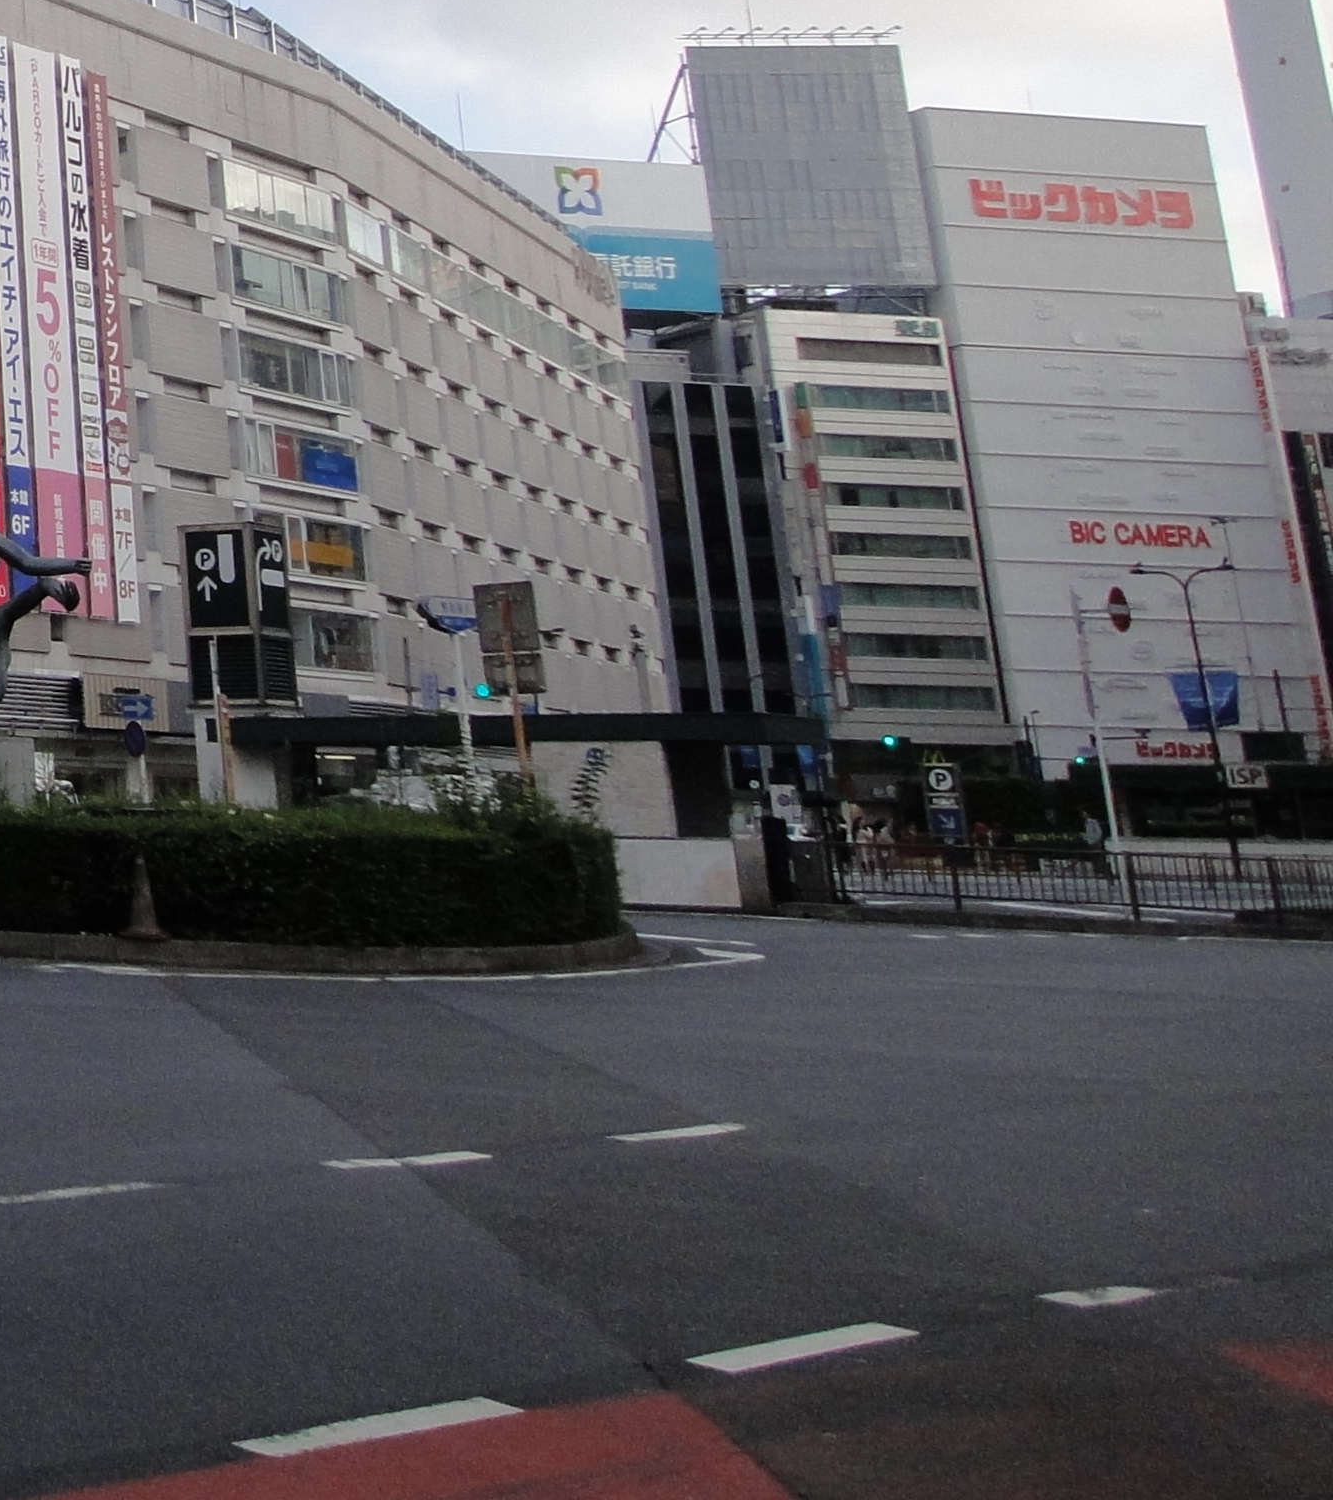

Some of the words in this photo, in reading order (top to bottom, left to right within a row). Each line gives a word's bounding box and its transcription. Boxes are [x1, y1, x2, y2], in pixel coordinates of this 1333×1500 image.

[63, 64, 90, 271] パルコの水着
[967, 178, 1194, 230] ビックカメラ
[101, 223, 121, 406] レストランフロア
[12, 514, 30, 535] 6F
[1069, 520, 1106, 544] BIC
[1115, 521, 1211, 548] CAMERA
[116, 531, 133, 550] 7F
[119, 579, 135, 599] 8F
